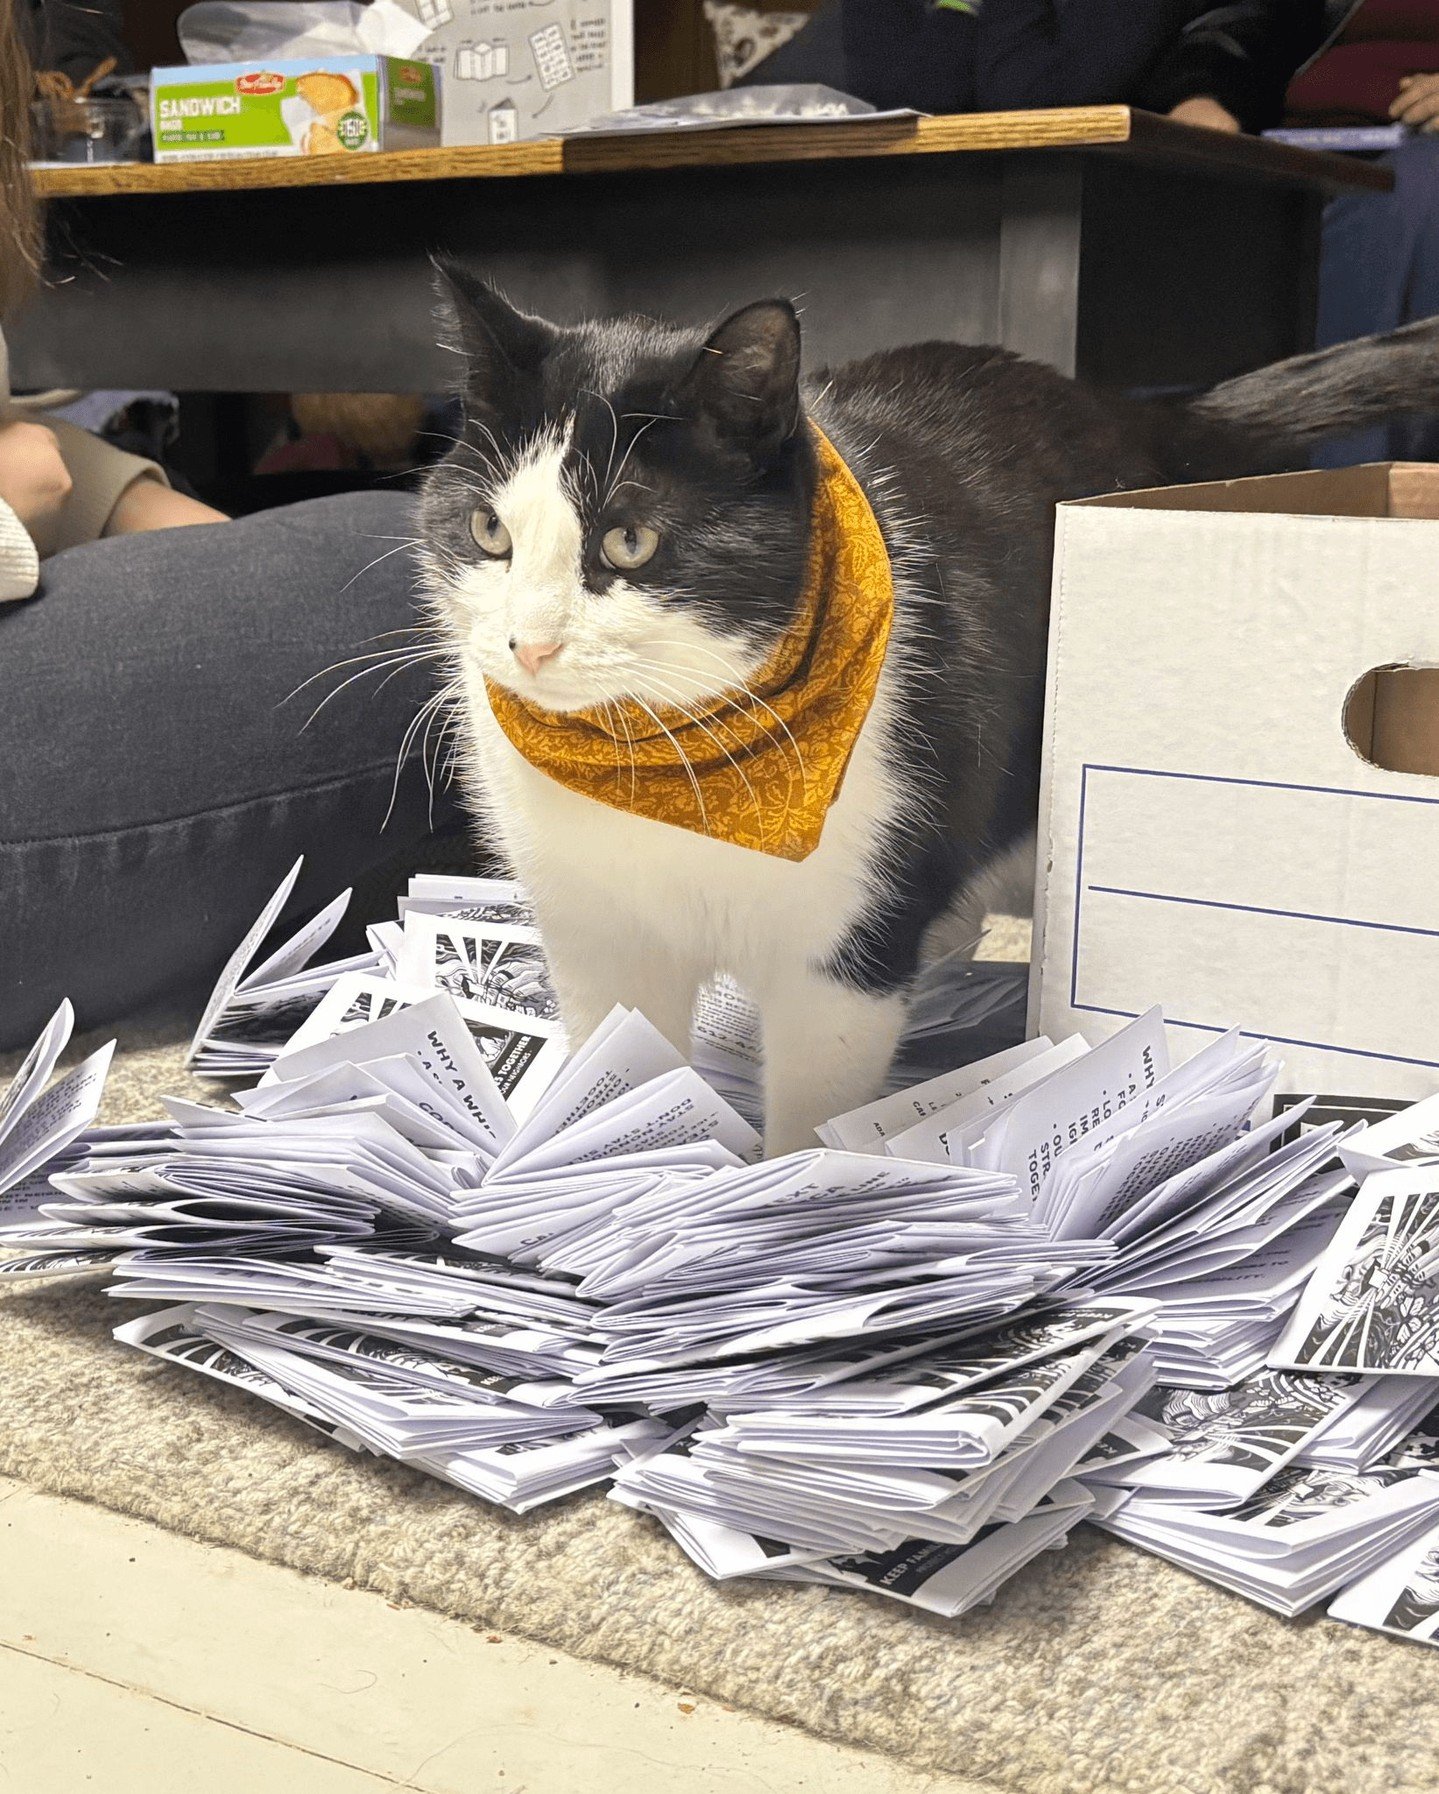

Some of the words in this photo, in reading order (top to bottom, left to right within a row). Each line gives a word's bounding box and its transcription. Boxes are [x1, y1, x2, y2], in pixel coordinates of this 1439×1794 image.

[160, 97, 241, 118] SANDWICH
[427, 1030, 458, 1072] WHY
[452, 1079, 466, 1091] A
[497, 1036, 532, 1075] TOGETHER
